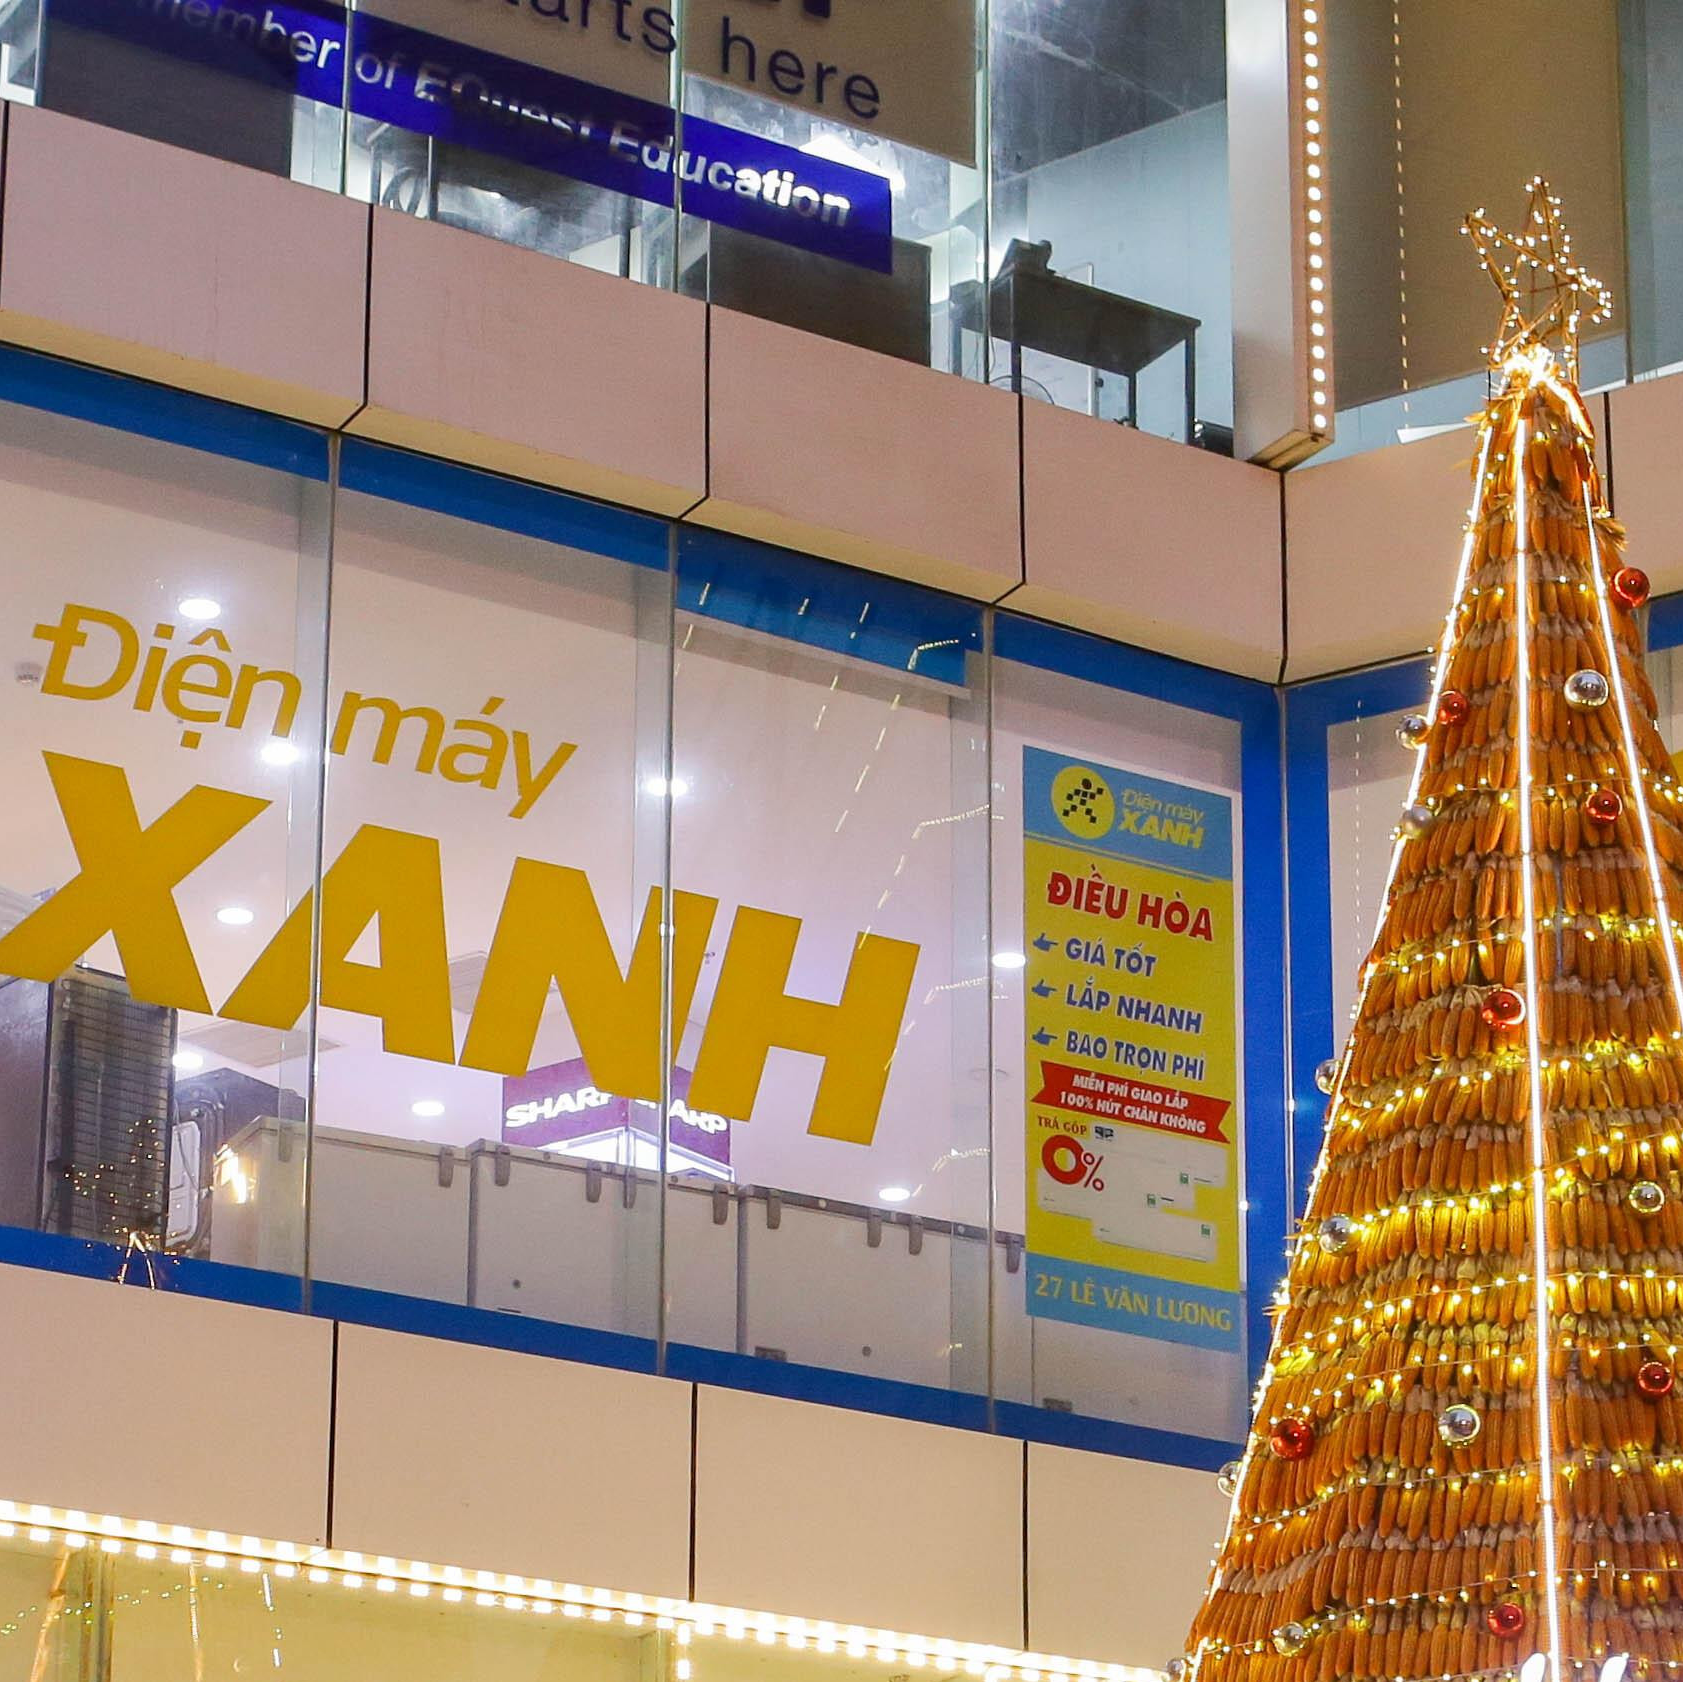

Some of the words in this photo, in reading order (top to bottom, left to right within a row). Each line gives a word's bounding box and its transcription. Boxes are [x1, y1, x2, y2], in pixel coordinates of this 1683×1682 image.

[720, 16, 880, 119] here
[354, 52, 406, 91] of
[608, 124, 852, 230] Education
[32, 600, 303, 750] Điện
[330, 695, 579, 820] máy
[1119, 811, 1205, 849] XANH
[1046, 864, 1129, 920] ĐIỀU
[1137, 891, 1214, 942] HÒA
[1064, 936, 1106, 968] GIÁ
[1114, 942, 1157, 978] TỐT
[1065, 975, 1110, 1012] LẮP
[1116, 994, 1204, 1035] NHANH
[1065, 1029, 1109, 1059] BAO
[1113, 1040, 1166, 1075] TRỌN
[1059, 1091, 1094, 1110] 100%
[1096, 1096, 1122, 1116] HÚT
[1131, 1087, 1163, 1105] GIAO
[1041, 1134, 1105, 1192] 0%
[1035, 1273, 1063, 1298] 27
